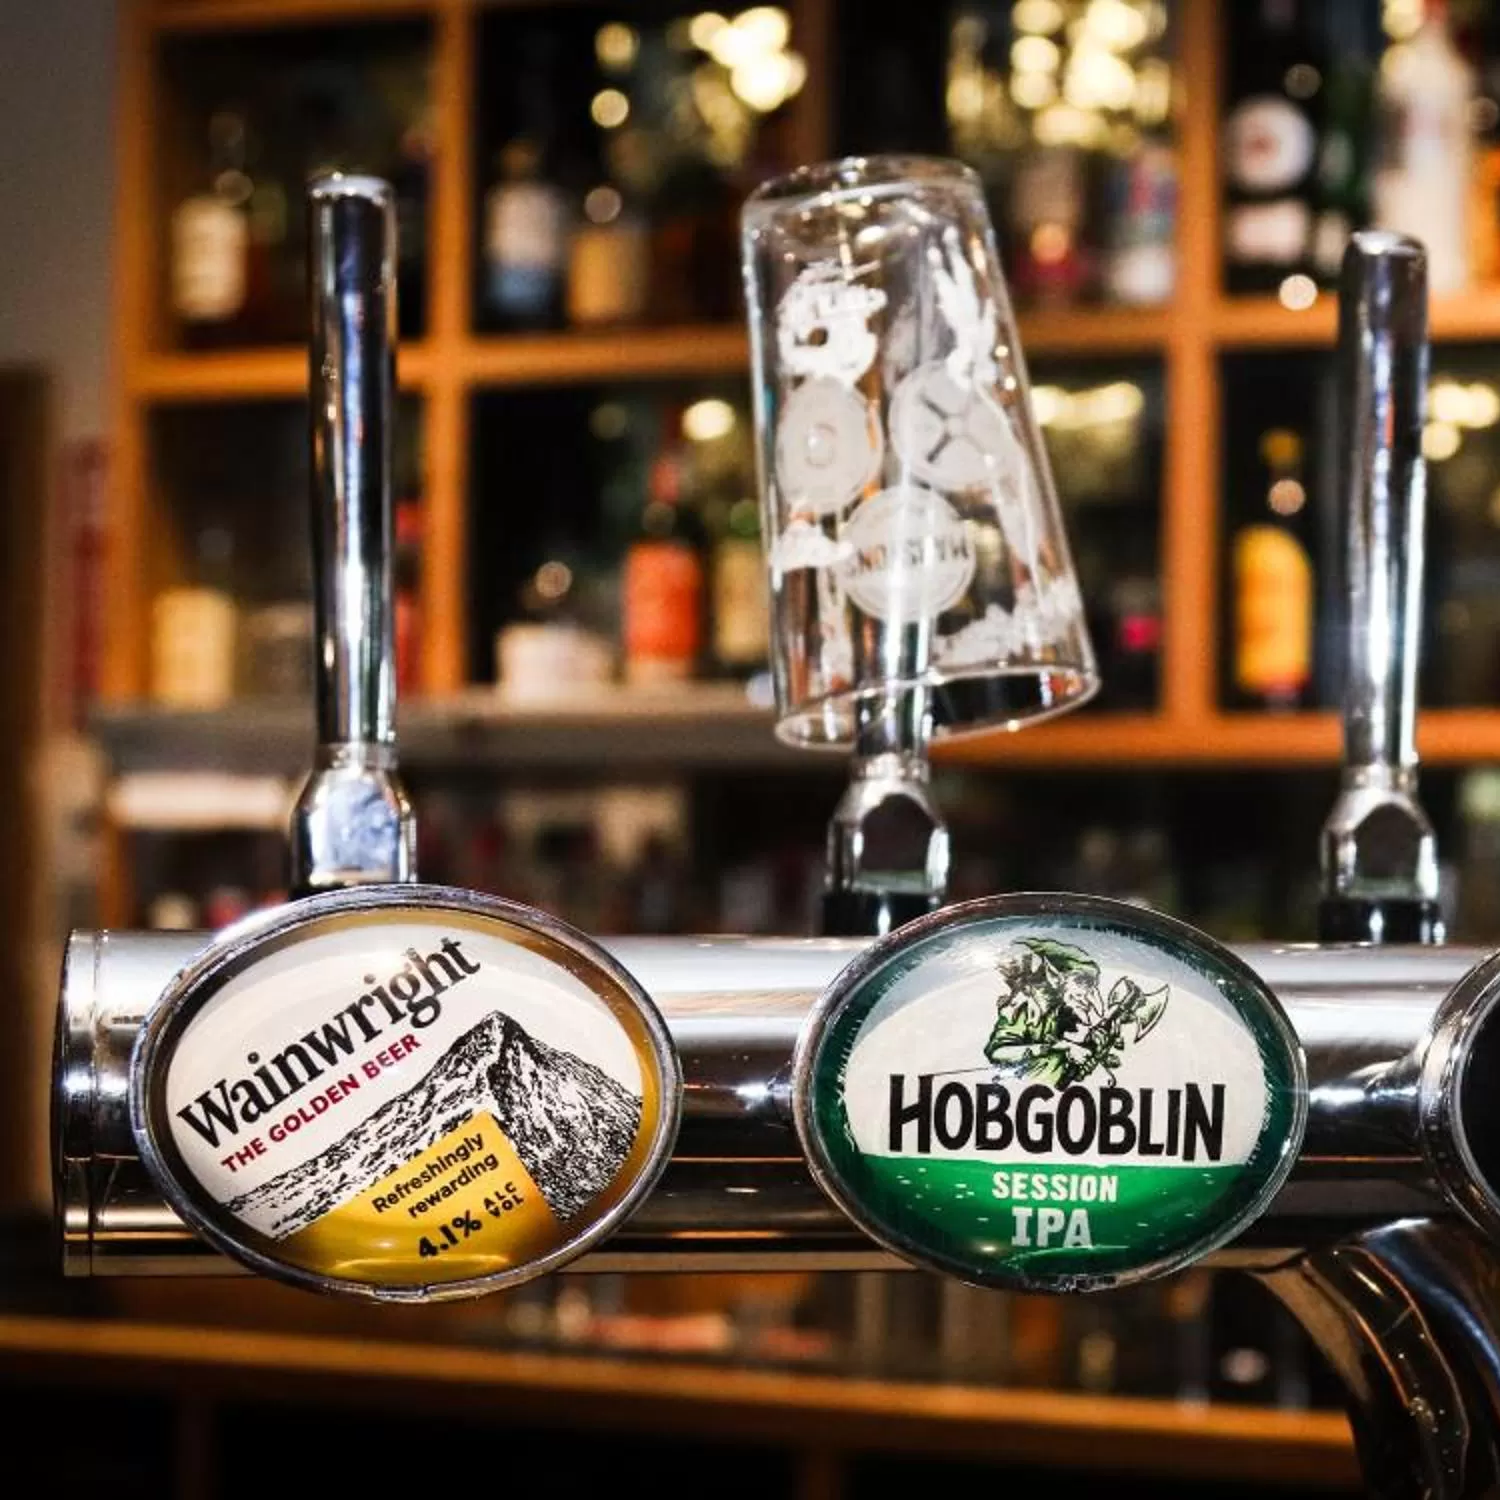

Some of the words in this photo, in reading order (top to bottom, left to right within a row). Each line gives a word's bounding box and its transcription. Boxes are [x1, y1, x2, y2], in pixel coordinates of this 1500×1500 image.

[176, 937, 481, 1149] Wainwright
[221, 1137, 268, 1173] THE
[268, 1073, 361, 1143] GOLDEN
[360, 1033, 423, 1080] BEER
[887, 1073, 1226, 1162] HOBGOBLIN
[371, 1133, 485, 1214] Refreshingly
[407, 1153, 500, 1219] rewarding
[488, 1194, 525, 1218] VOL
[991, 1171, 1119, 1203] SESSION
[418, 1209, 483, 1258] 4.1%
[483, 1181, 517, 1209] ALC
[1010, 1206, 1093, 1249] IPA
